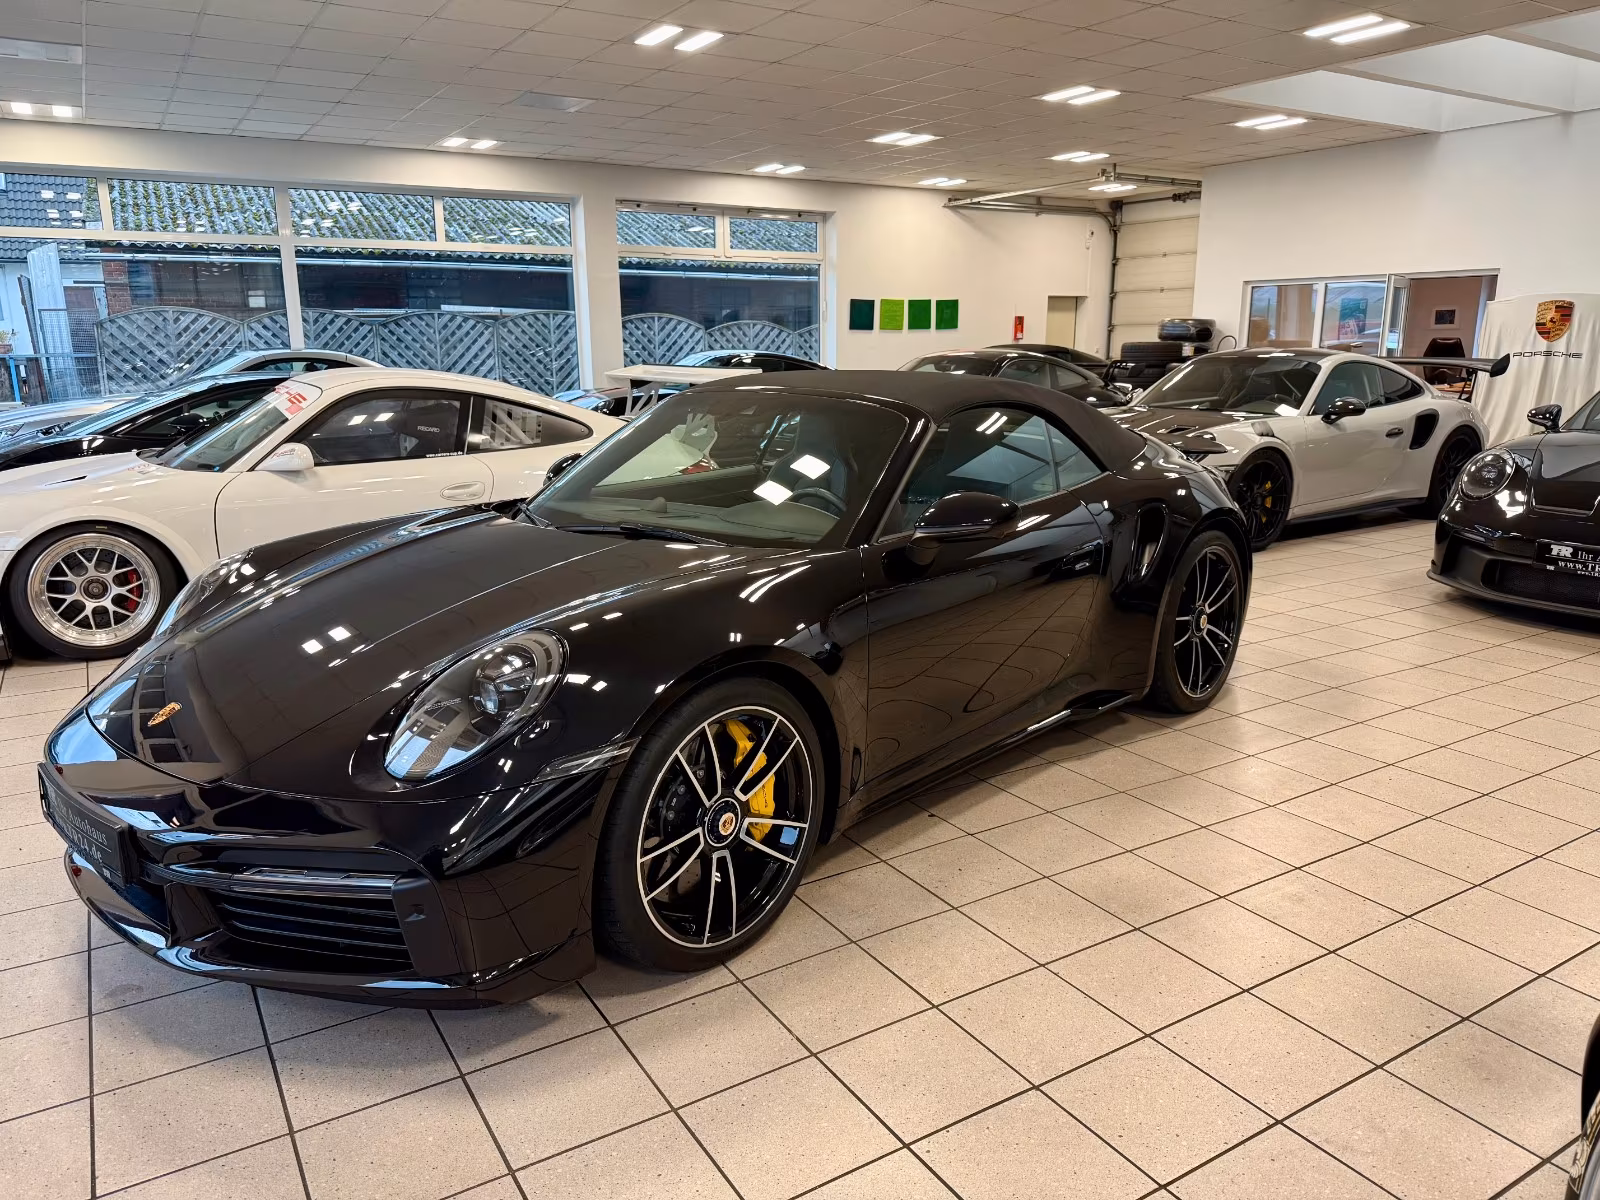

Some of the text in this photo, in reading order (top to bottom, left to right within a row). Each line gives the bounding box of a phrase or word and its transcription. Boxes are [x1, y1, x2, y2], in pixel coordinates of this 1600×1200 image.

[1512, 350, 1583, 359] PORSCHE
[1577, 550, 1594, 560] Ihr
[69, 808, 107, 846] Autohaus
